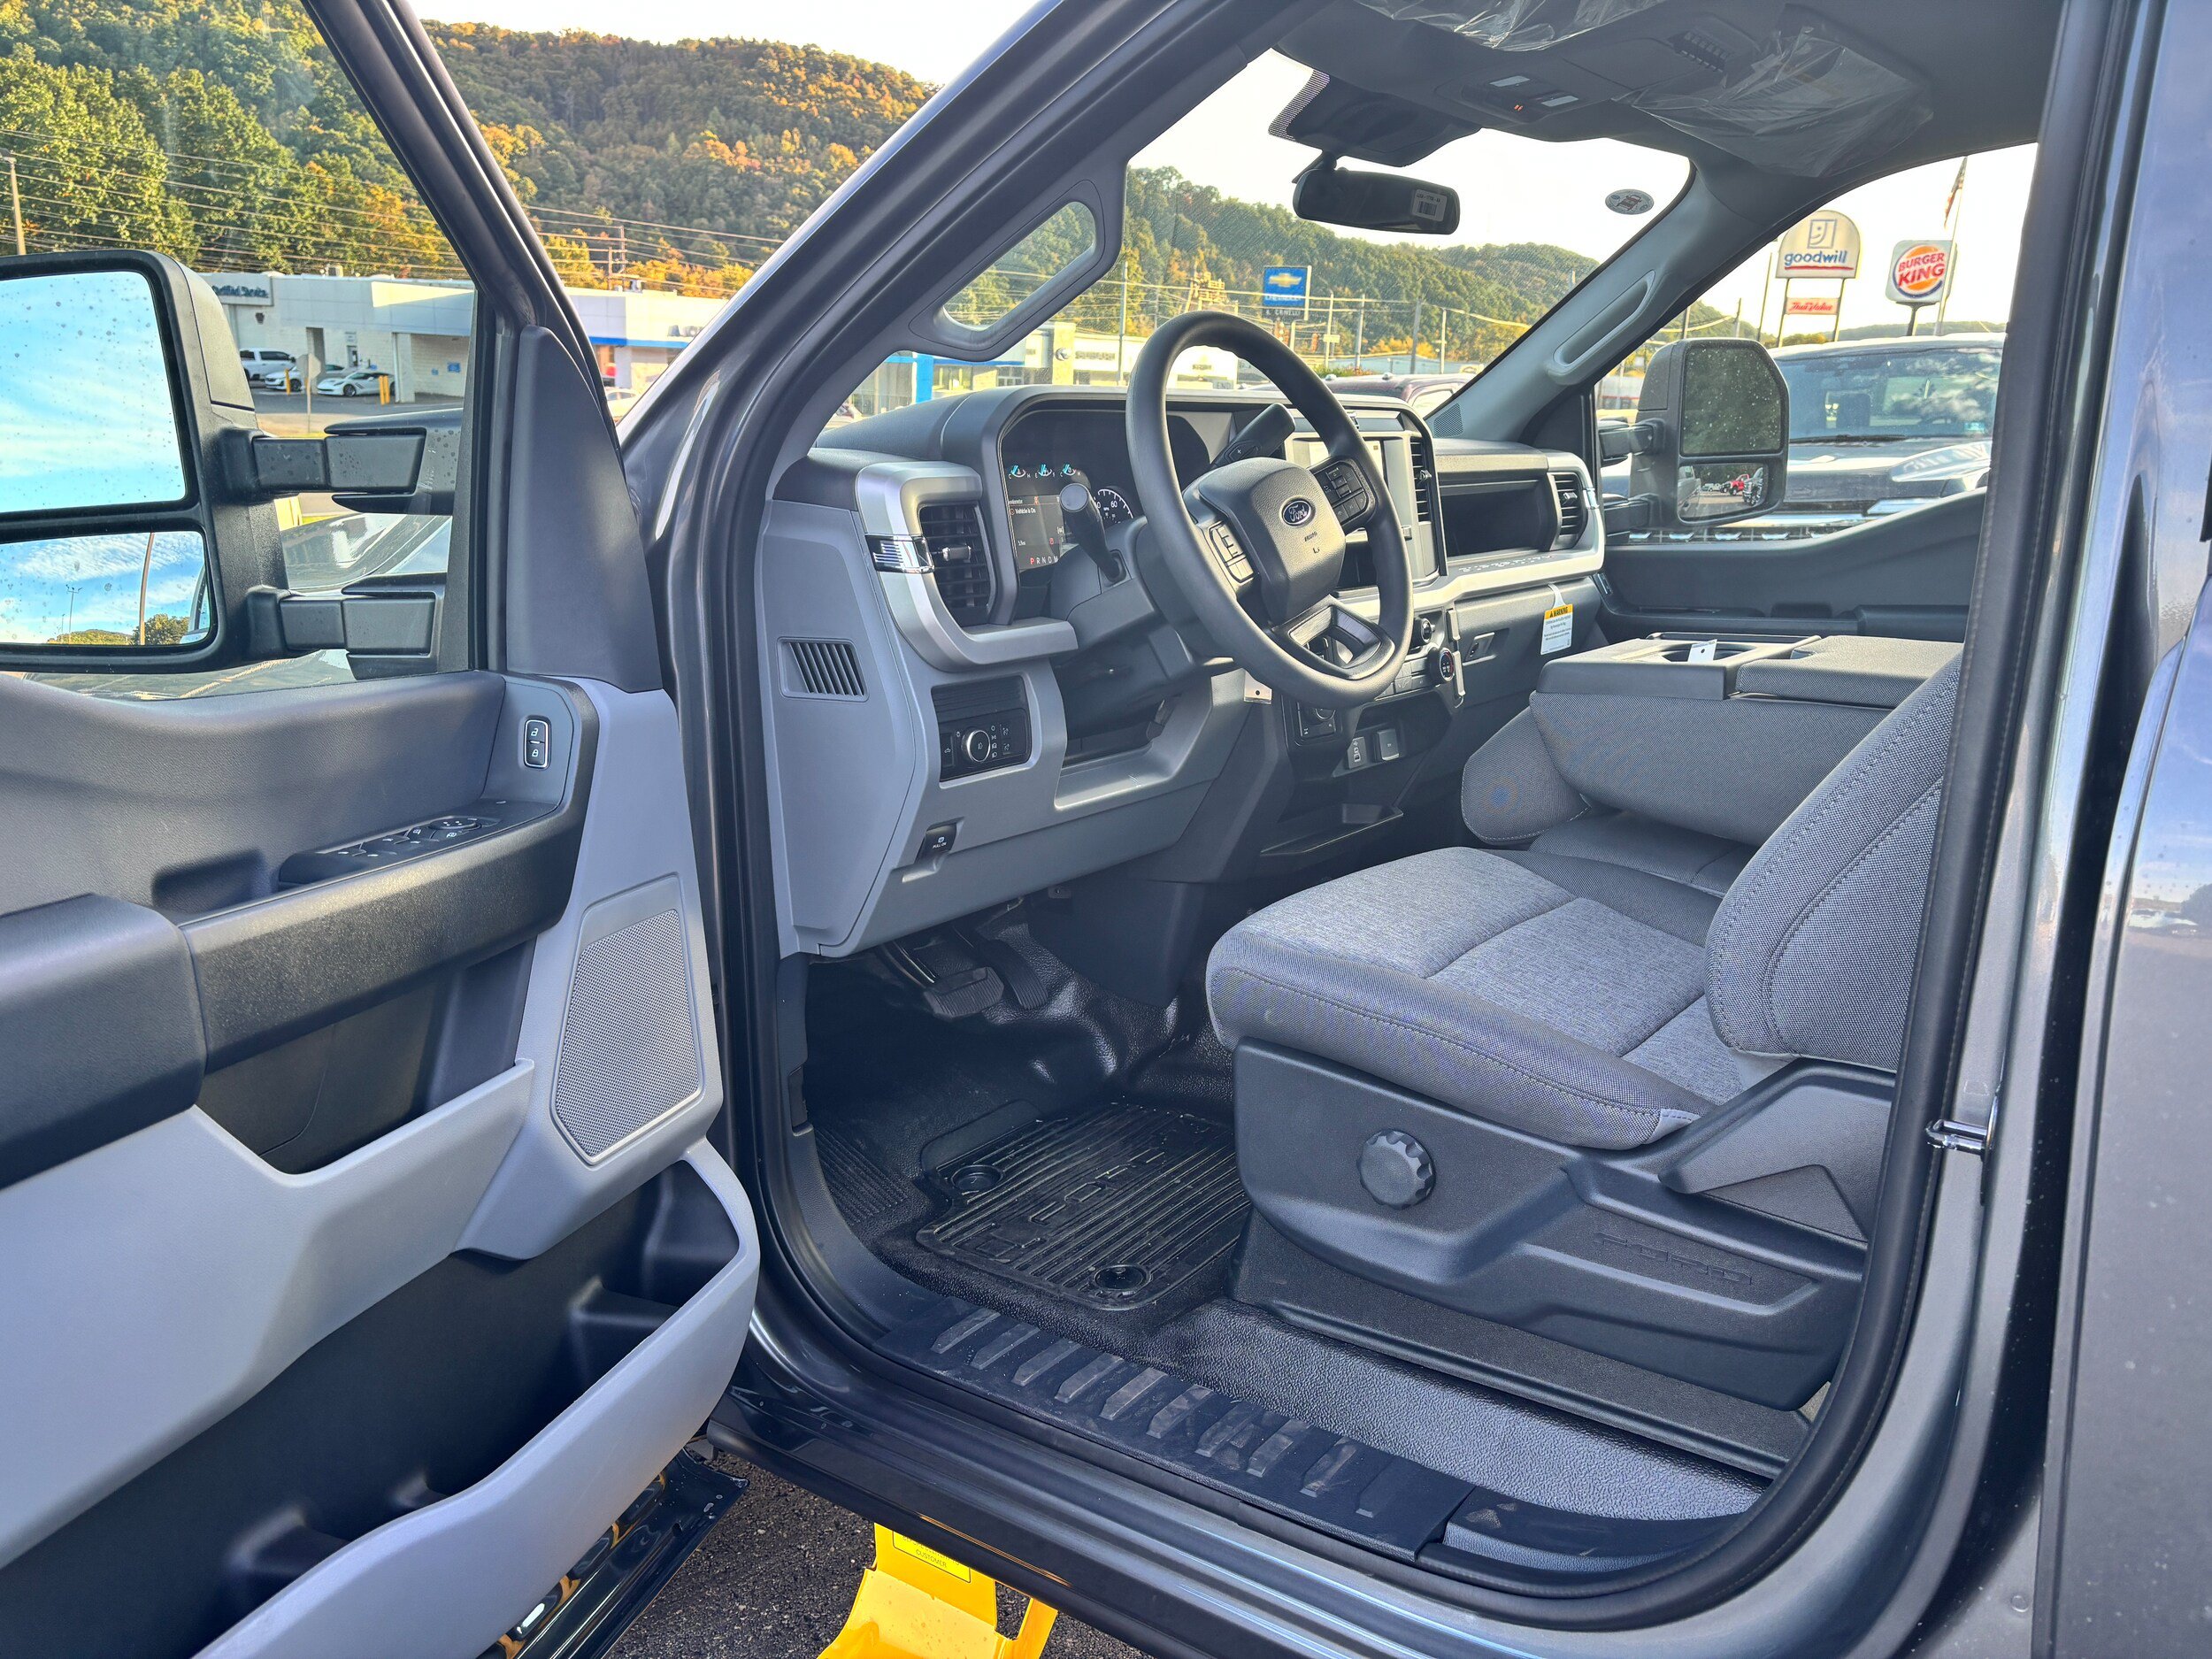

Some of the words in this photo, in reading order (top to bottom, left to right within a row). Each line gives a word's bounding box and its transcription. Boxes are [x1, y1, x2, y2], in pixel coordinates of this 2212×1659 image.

[1784, 250, 1847, 266] goodwill
[1898, 252, 1945, 273] BURGER
[1898, 263, 1946, 287] KING
[1288, 504, 1308, 522] Ford
[915, 1548, 948, 1569] CUSTOMER
